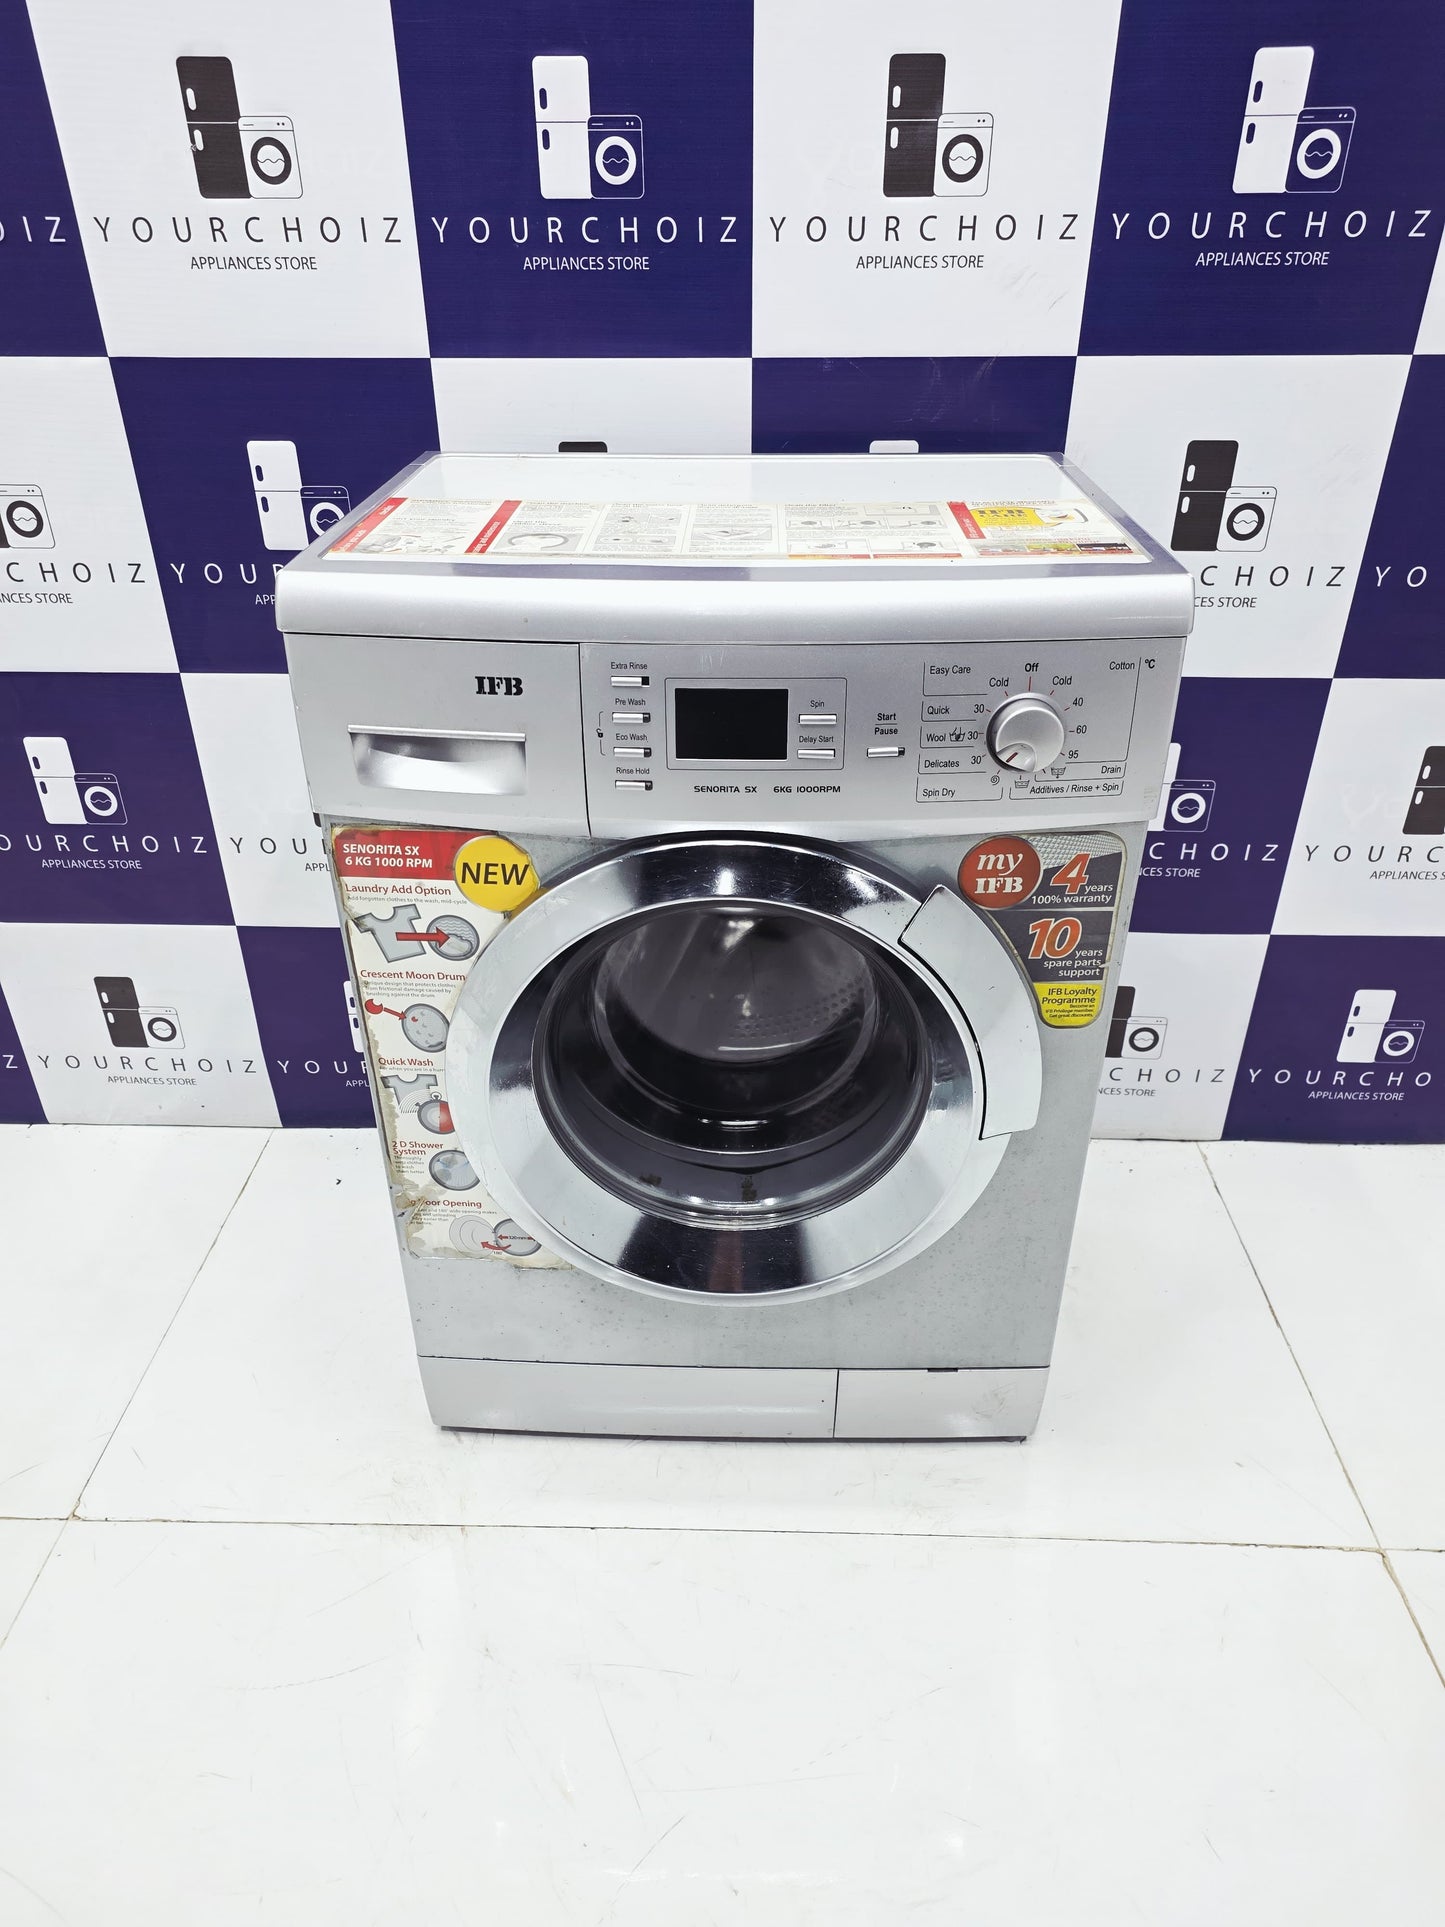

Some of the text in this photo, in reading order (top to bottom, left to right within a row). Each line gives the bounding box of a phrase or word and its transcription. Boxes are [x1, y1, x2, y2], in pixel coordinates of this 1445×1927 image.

[93, 216, 402, 243] YOURCHOIZ
[431, 217, 736, 243] YOURCHOIZ
[770, 214, 1079, 243] YOURCHOIZ
[1113, 210, 1431, 240] YOURCHOIZ
[190, 256, 317, 271] APPLIANCES STORE
[523, 256, 649, 271] APPLIANCES STORE
[856, 255, 984, 269] APPLIANCES STORE
[1195, 251, 1330, 267] APPLIANCES STORE
[34, 593, 74, 604] STORE
[1217, 597, 1258, 608] STORE
[611, 661, 648, 670] Extra Rinse
[929, 665, 971, 676] Easy Care
[1024, 662, 1039, 672] Off
[1109, 661, 1135, 670] Cotton
[989, 677, 1009, 687] Cold
[1052, 675, 1072, 686] Cold
[475, 676, 523, 696] IFB
[615, 698, 646, 706] Pre Wash
[810, 700, 825, 709] Spin
[1072, 697, 1083, 707] 40
[927, 705, 950, 716] Quick
[973, 704, 985, 713] 30
[877, 712, 896, 721] Start
[874, 726, 898, 735] Pause
[1076, 725, 1087, 735] 60
[615, 733, 648, 742] Eco Wash
[799, 735, 834, 745] Delay Start
[926, 732, 946, 742] Wool
[967, 731, 978, 740] 30
[1068, 749, 1079, 759] 95
[924, 758, 960, 769] Delicates
[971, 755, 982, 765] 30
[616, 767, 650, 775] Rinse Hold
[1101, 764, 1121, 774] Drain
[694, 785, 740, 793] SENORITA
[922, 787, 956, 799] Spin Dry
[1029, 784, 1064, 795] Additives
[1072, 783, 1093, 793] Rinse
[1102, 782, 1119, 793] Spin
[229, 837, 327, 854] YOU
[343, 843, 419, 856] SENORITA SX
[42, 859, 143, 869] APPLIANCES STORE
[345, 856, 433, 868] 6 KG 1000 RPM
[977, 852, 1023, 876] my
[461, 862, 529, 886] NEW
[1050, 852, 1113, 894] 4 years
[1165, 867, 1200, 878] STORE
[1369, 870, 1438, 880] APPLIANCES
[345, 884, 451, 896] Laundry Add Option
[974, 877, 1023, 894] IFB
[1031, 894, 1112, 905] 100% warranty
[1028, 917, 1103, 960] 10 years
[1044, 958, 1101, 968] spare parts
[360, 969, 467, 981] Crescent Moon Drum
[1058, 968, 1101, 978] support
[1048, 987, 1097, 996] IFB Loyalty
[1041, 997, 1096, 1006] Programme
[38, 1055, 256, 1073] YOURCHOIZ
[378, 1057, 434, 1067] Quick Wash
[107, 1075, 197, 1086] APPLIANCES STORE
[1124, 1088, 1156, 1097] STORE
[1308, 1090, 1405, 1100] APPLIANCES STORE
[409, 1141, 444, 1149] Shower
[393, 1148, 426, 1156] System
[442, 1200, 482, 1208] Opening
